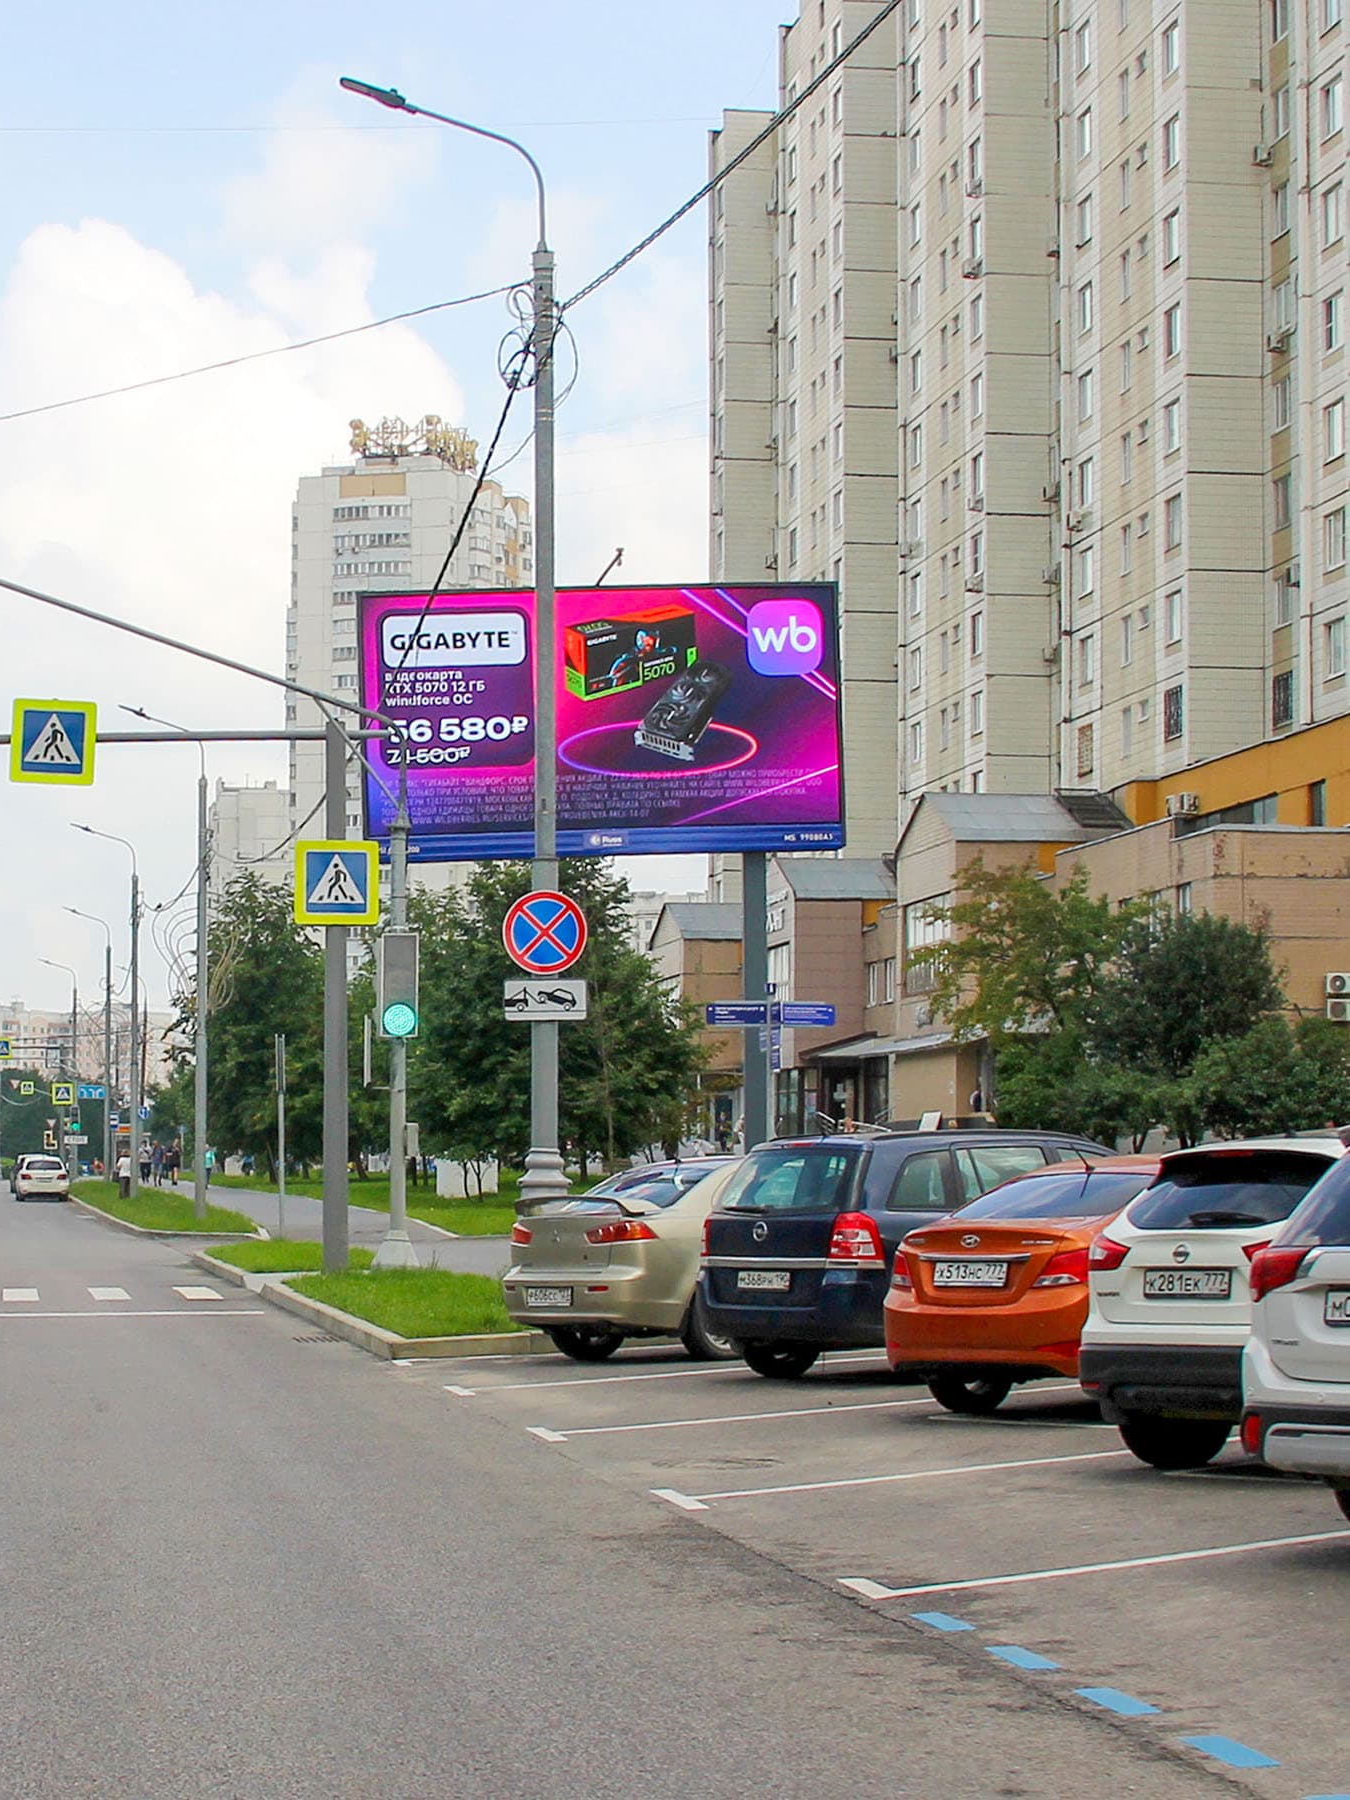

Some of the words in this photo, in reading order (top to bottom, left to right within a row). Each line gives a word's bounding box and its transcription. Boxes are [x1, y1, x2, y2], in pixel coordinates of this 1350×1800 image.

[752, 615, 817, 653] wb
[643, 661, 676, 681] 5070
[415, 681, 448, 693] 5070
[451, 681, 466, 692] 12
[469, 680, 486, 692] ГБ
